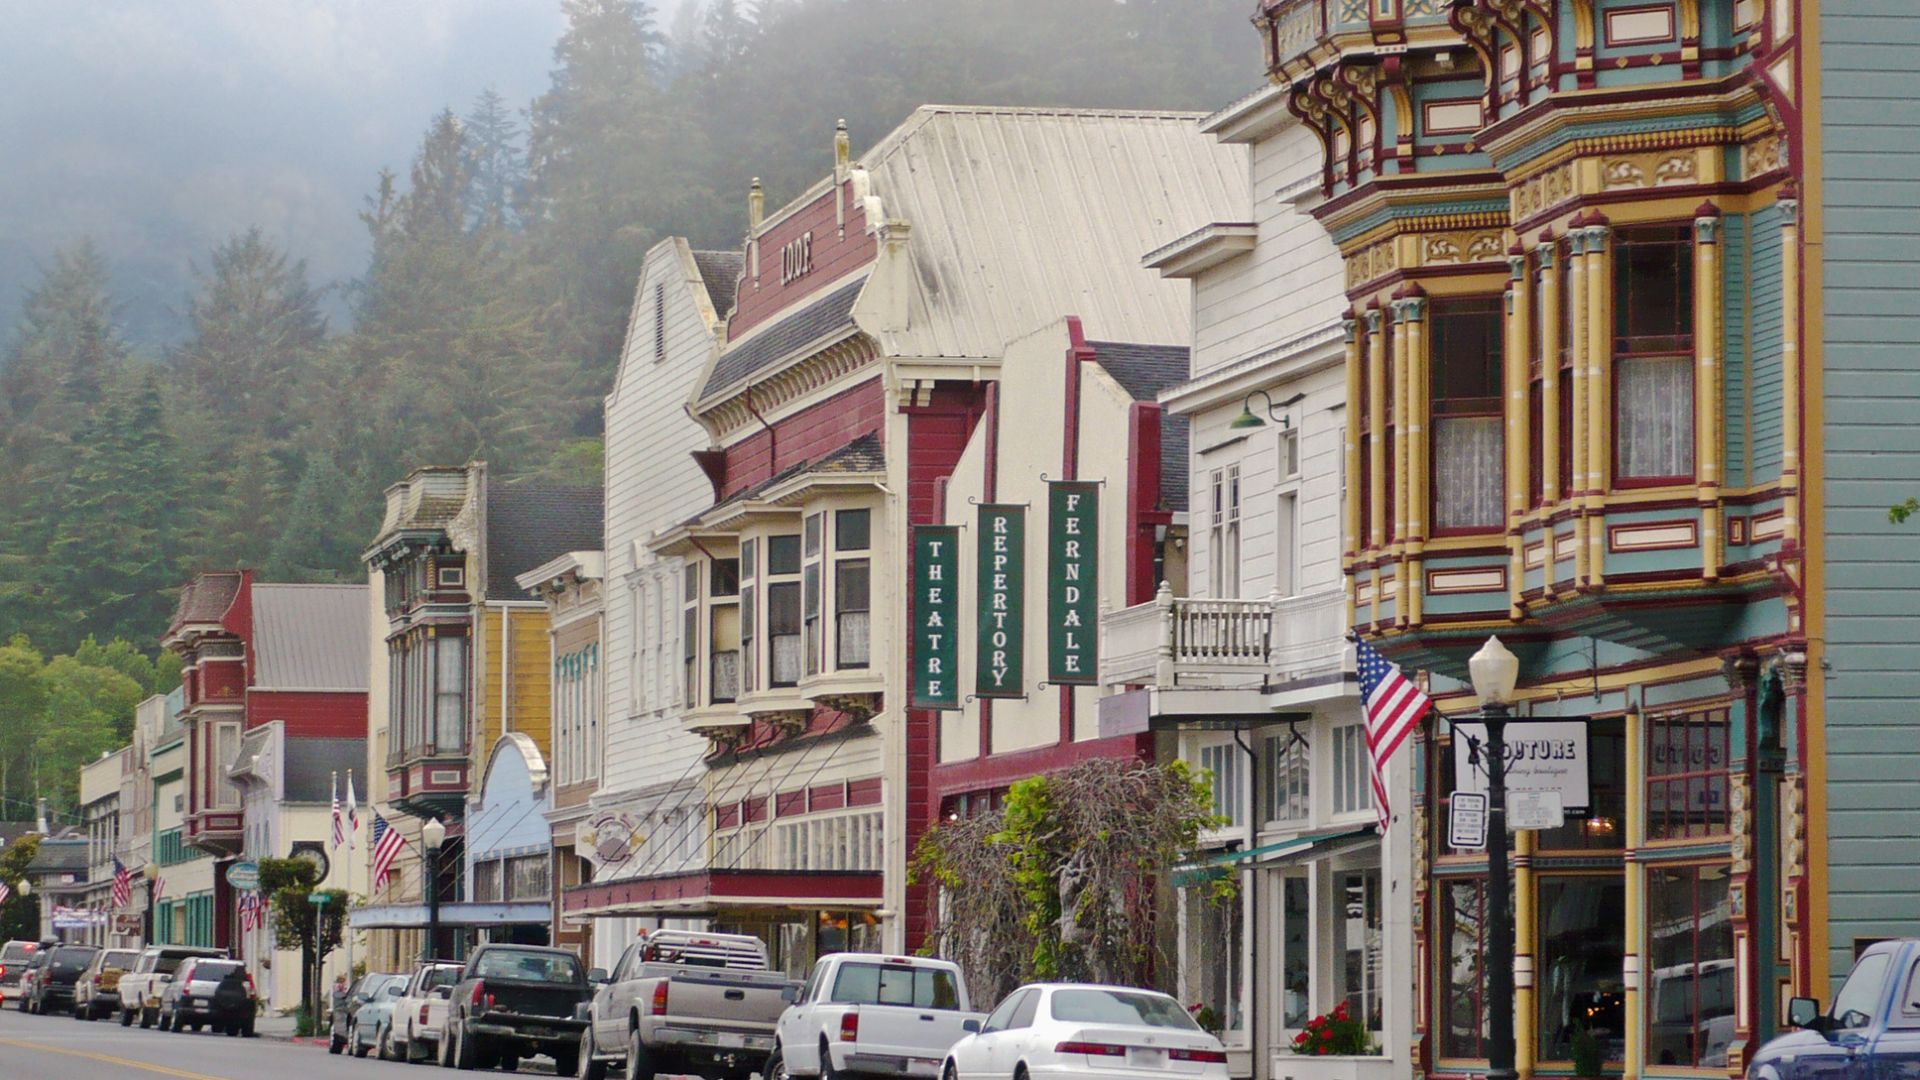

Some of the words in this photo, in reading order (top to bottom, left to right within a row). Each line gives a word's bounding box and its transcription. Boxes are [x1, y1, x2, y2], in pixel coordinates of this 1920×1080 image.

[927, 541, 944, 697] THEATRE
[992, 516, 1008, 686] REPERTORY
[1063, 494, 1081, 673] FERNDALE
[1503, 740, 1576, 760] OUTURE
